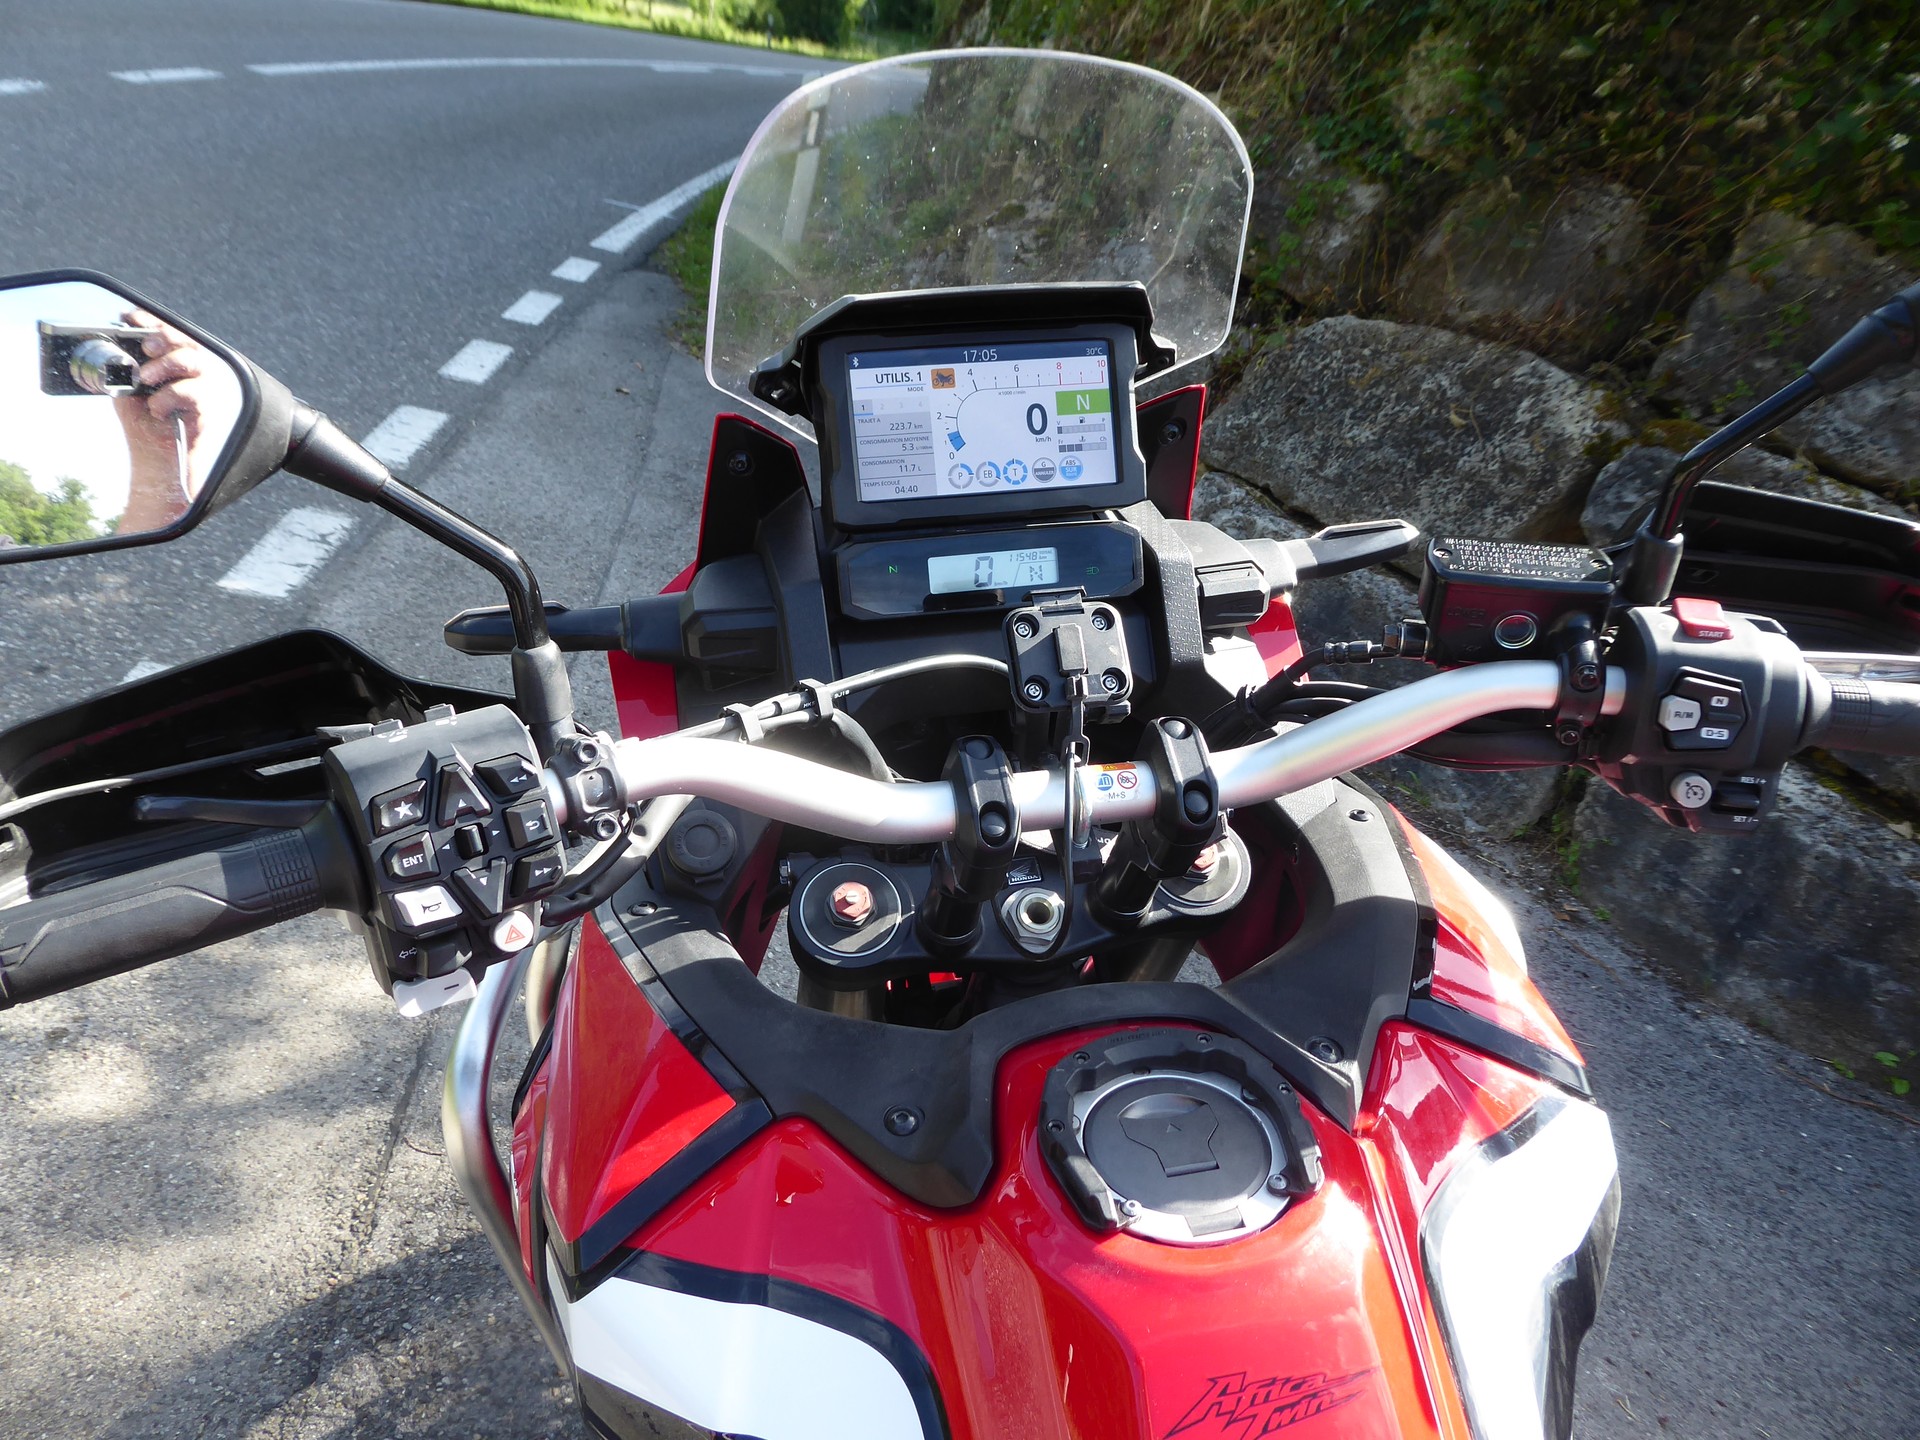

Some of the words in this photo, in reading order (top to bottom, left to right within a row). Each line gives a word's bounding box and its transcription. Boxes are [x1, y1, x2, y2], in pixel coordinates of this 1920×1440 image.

[963, 349, 998, 362] 17:05
[1085, 348, 1103, 356] 30°C
[1014, 364, 1019, 372] 6
[1056, 362, 1062, 370] 8
[1097, 360, 1106, 368] 10
[967, 368, 973, 376] 4
[875, 372, 914, 384] UTILIS.
[917, 371, 922, 382] 1
[1076, 394, 1090, 411] N
[937, 412, 942, 420] 2
[1026, 403, 1047, 435] 0
[889, 422, 912, 431] 223.7
[860, 437, 904, 446] CONSOMMATION
[903, 435, 930, 443] MOYENNE
[901, 443, 915, 451] 5.3
[949, 452, 955, 460] 0
[861, 458, 906, 467] CONSOMMATION
[899, 464, 916, 472] 11.7
[1013, 468, 1018, 476] T
[958, 472, 963, 480] P
[983, 470, 993, 479] EB
[881, 479, 900, 487] ÉCOULÉ
[894, 485, 919, 494] 04:40
[1010, 552, 1038, 562] 11548
[889, 565, 898, 574] N
[974, 555, 993, 587] 0
[1697, 630, 1725, 639] START
[1715, 697, 1725, 706] N
[1674, 710, 1694, 720] R/M
[1705, 729, 1725, 738] D-S
[1741, 776, 1755, 784] RES
[1108, 791, 1127, 800] M+S
[1733, 815, 1747, 823] SET
[402, 854, 424, 867] ENT
[1010, 873, 1039, 883] HONDA
[1162, 1371, 1376, 1440] Africa
